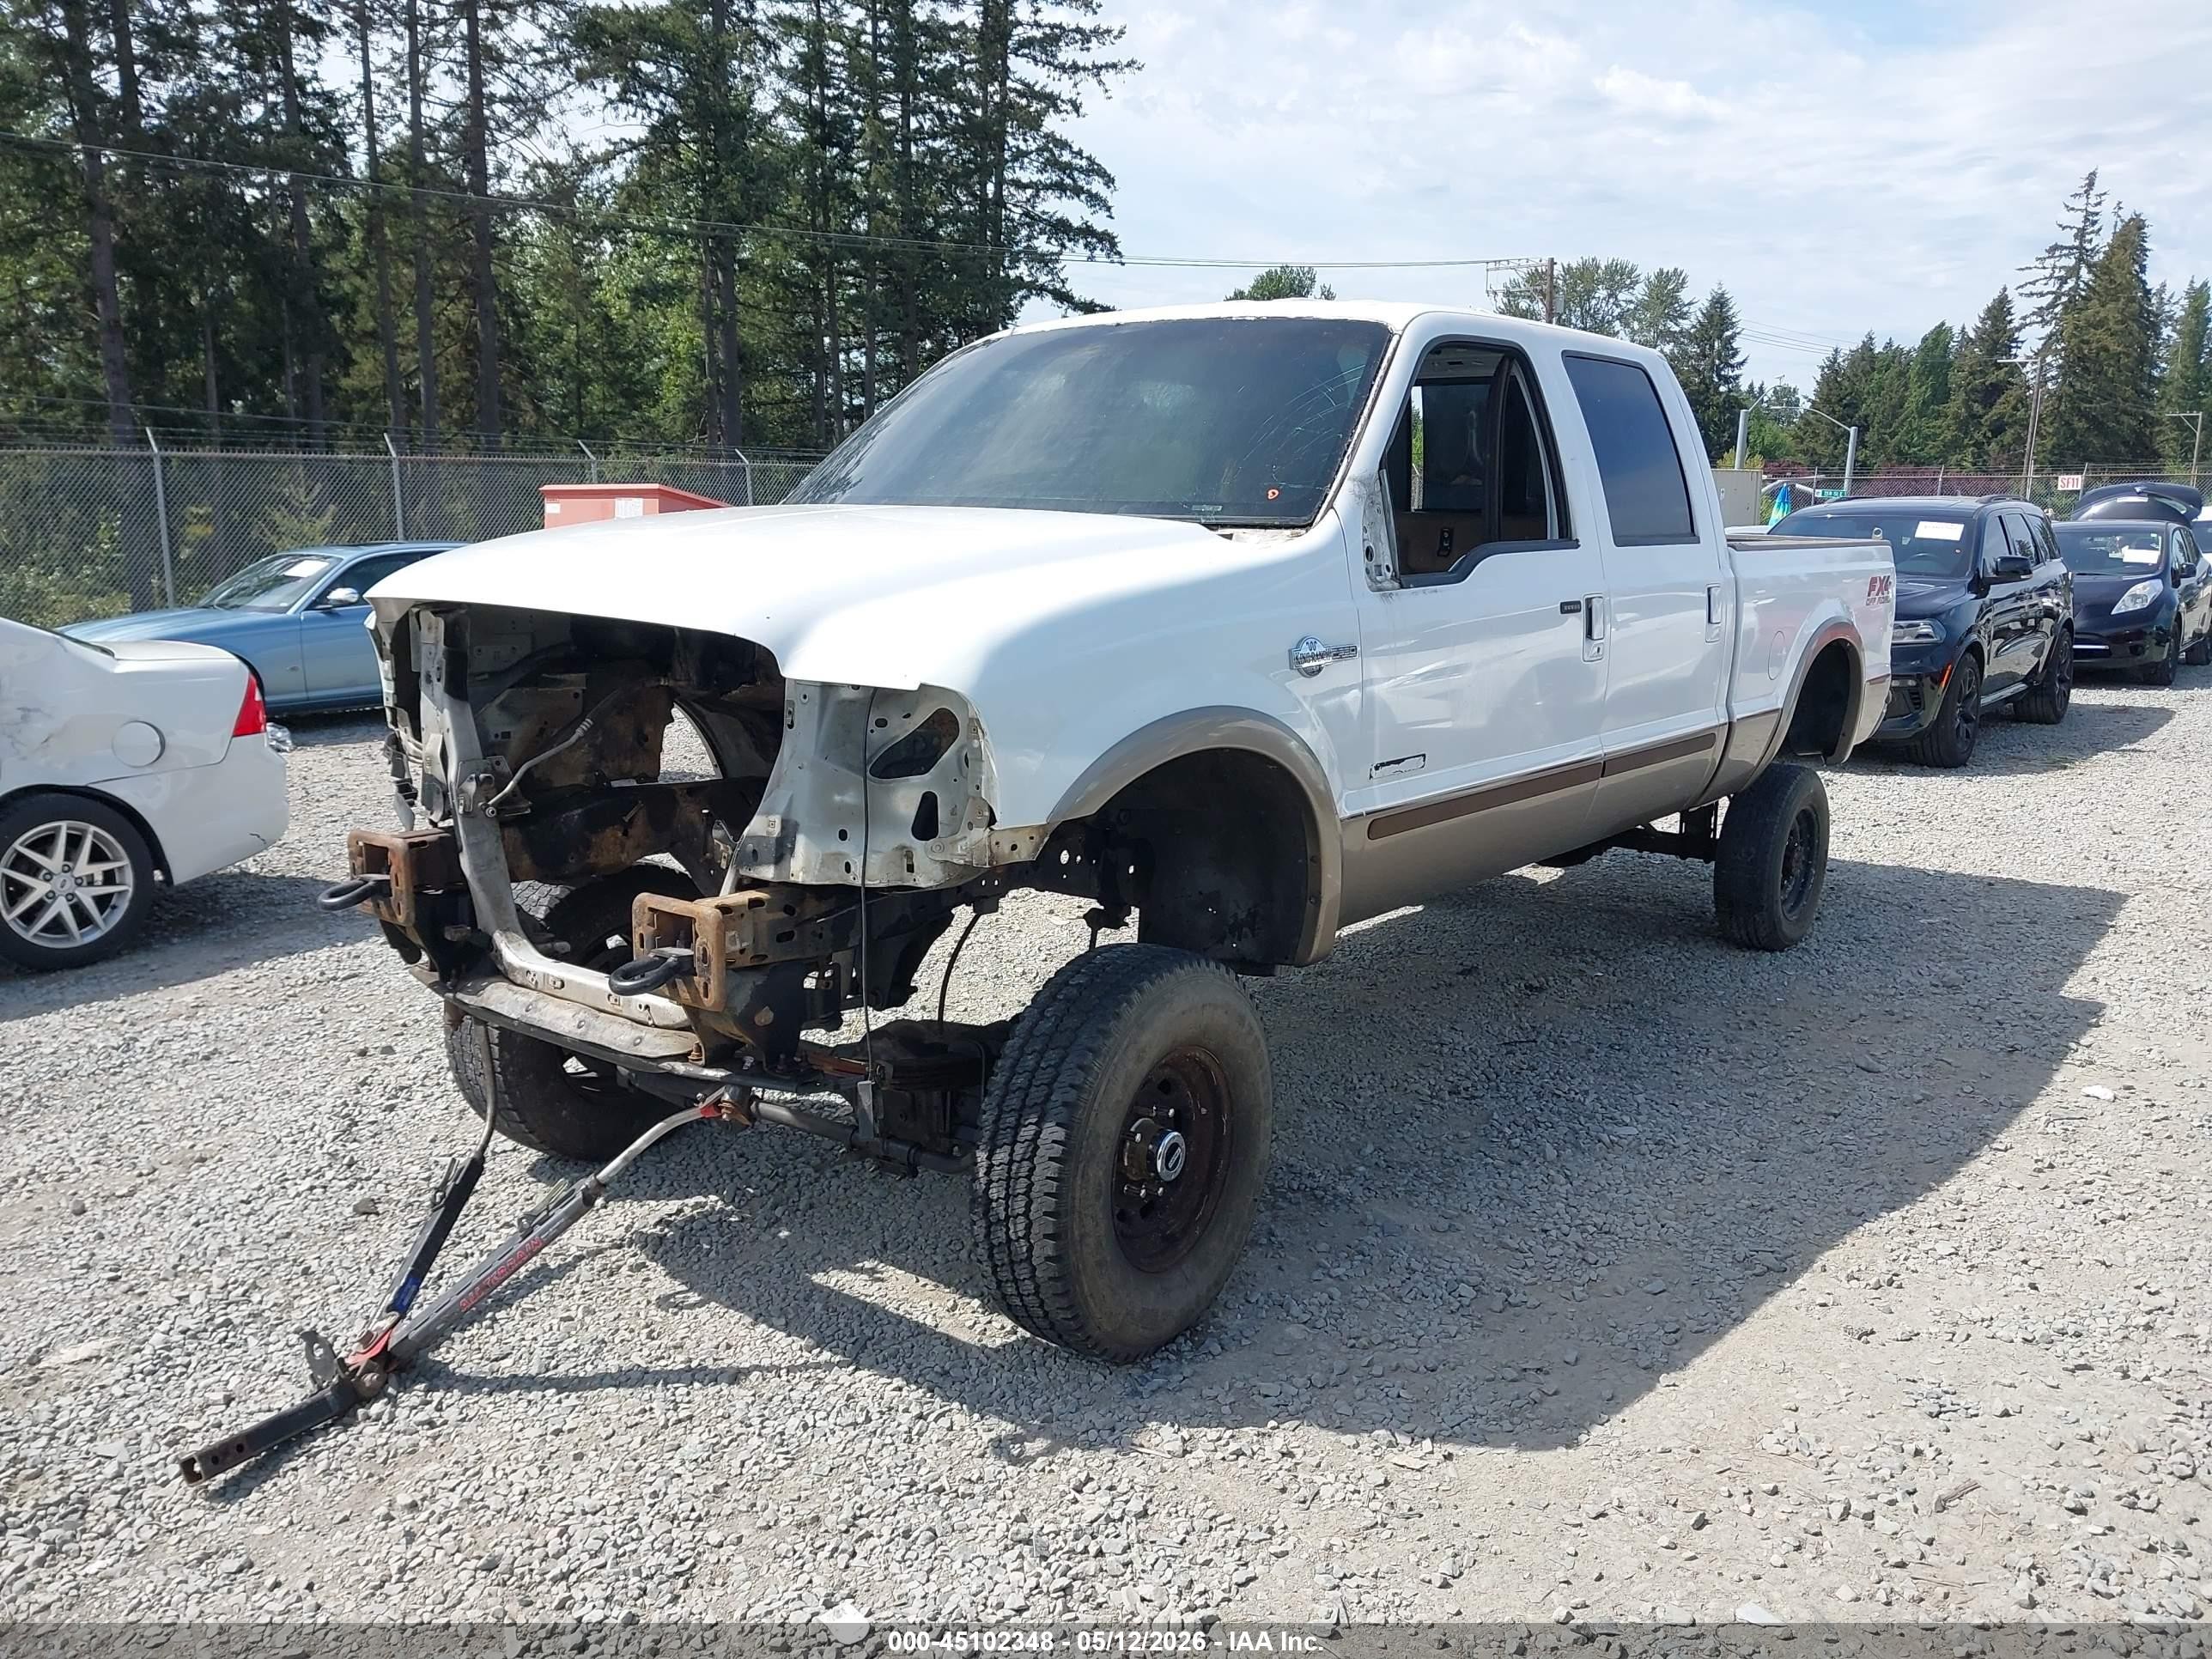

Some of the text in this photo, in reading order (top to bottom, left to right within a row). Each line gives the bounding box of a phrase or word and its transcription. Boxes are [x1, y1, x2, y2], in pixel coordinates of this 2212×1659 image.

[2060, 477, 2080, 489] SF11
[1867, 575, 1892, 597] FX4
[482, 1236, 544, 1289] TERRAIN
